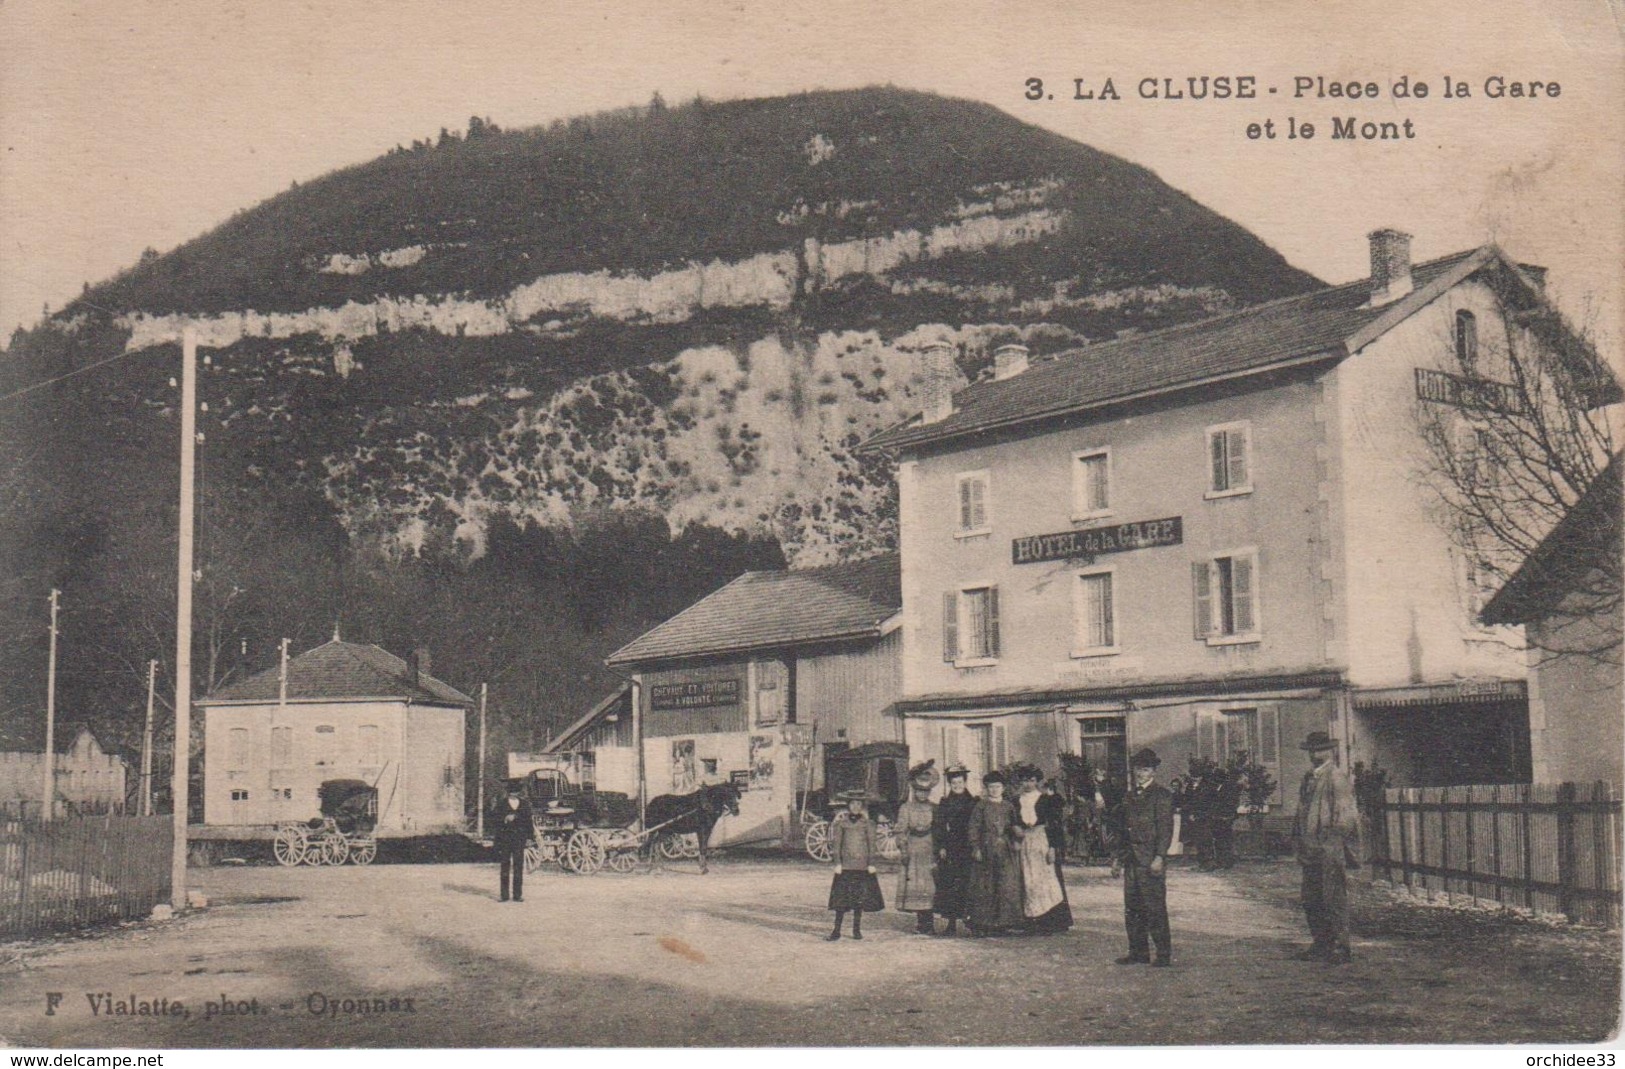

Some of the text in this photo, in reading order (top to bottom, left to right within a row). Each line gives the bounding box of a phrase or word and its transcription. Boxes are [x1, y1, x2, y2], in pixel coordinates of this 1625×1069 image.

[1085, 534, 1099, 551] de
[1101, 531, 1114, 549] la
[1118, 520, 1174, 546] GARE
[688, 684, 698, 694] ET
